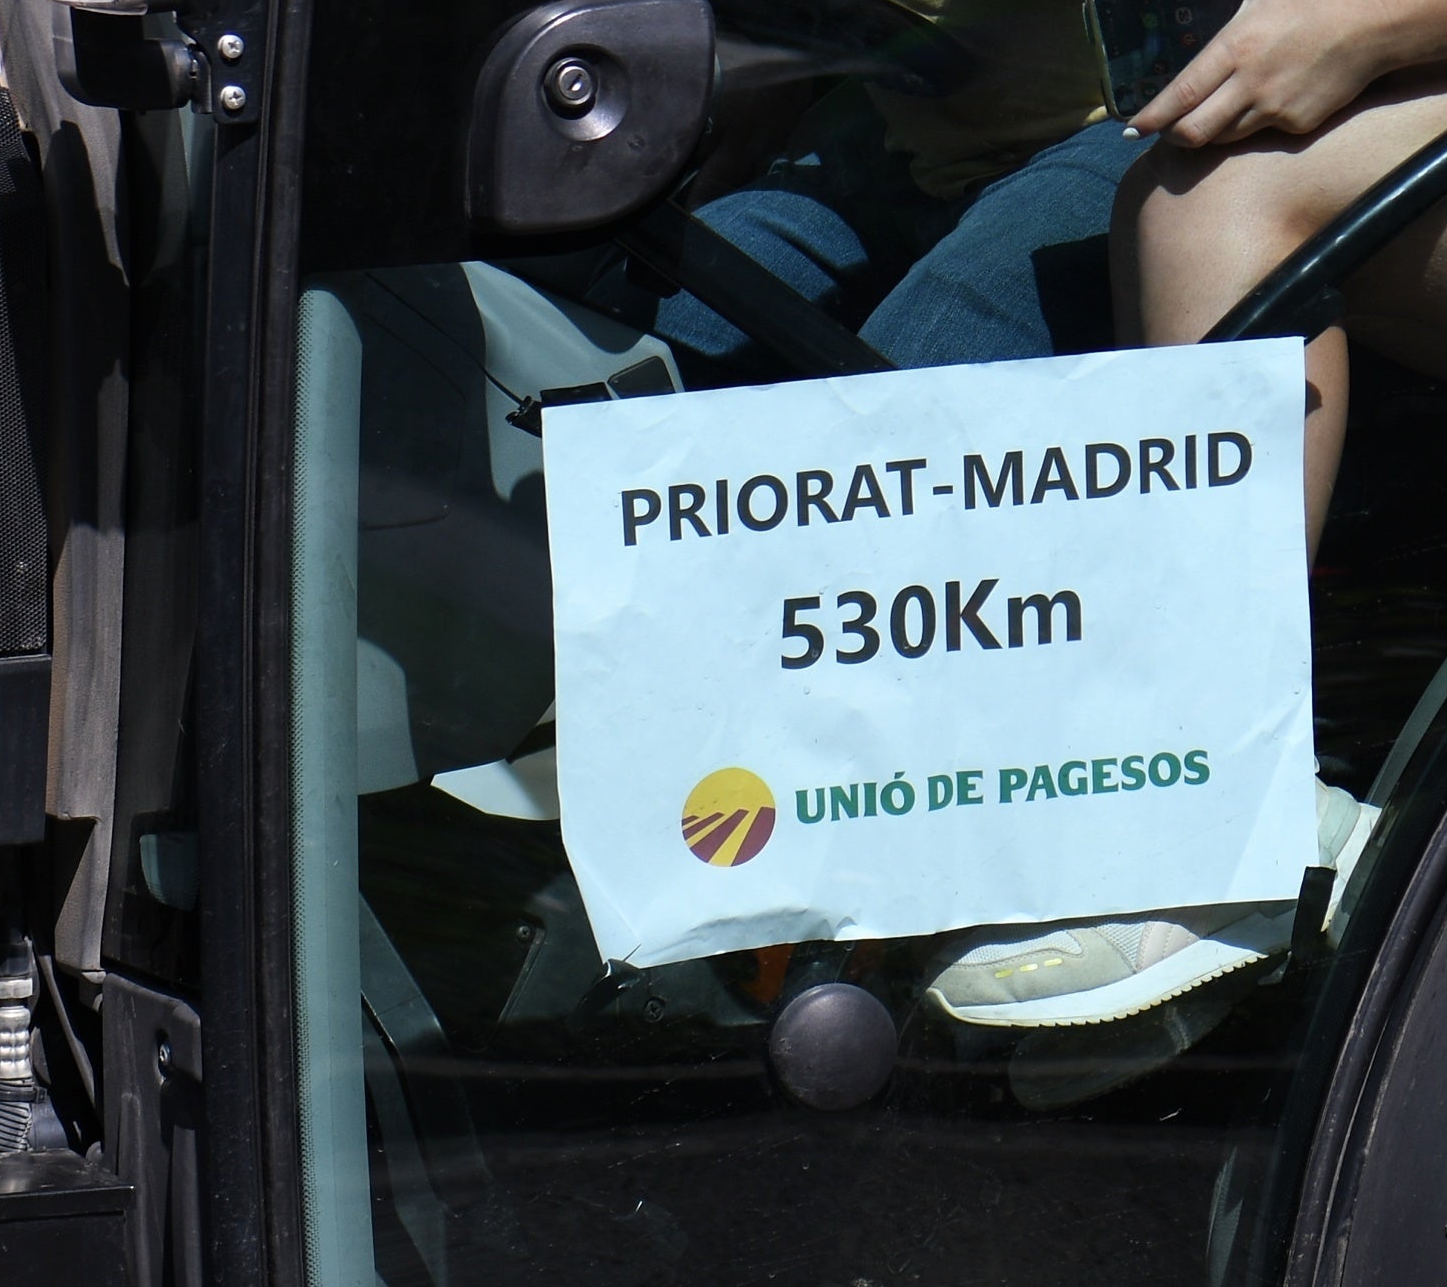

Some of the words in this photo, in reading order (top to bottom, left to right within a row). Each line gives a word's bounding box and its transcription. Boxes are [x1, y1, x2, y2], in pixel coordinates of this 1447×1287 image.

[621, 430, 1254, 547] PRIORAT-MADRID
[779, 578, 1084, 670] 530Km
[795, 771, 916, 825] UNIÓ
[928, 768, 984, 811] DE
[999, 749, 1211, 805] PAGESOS
